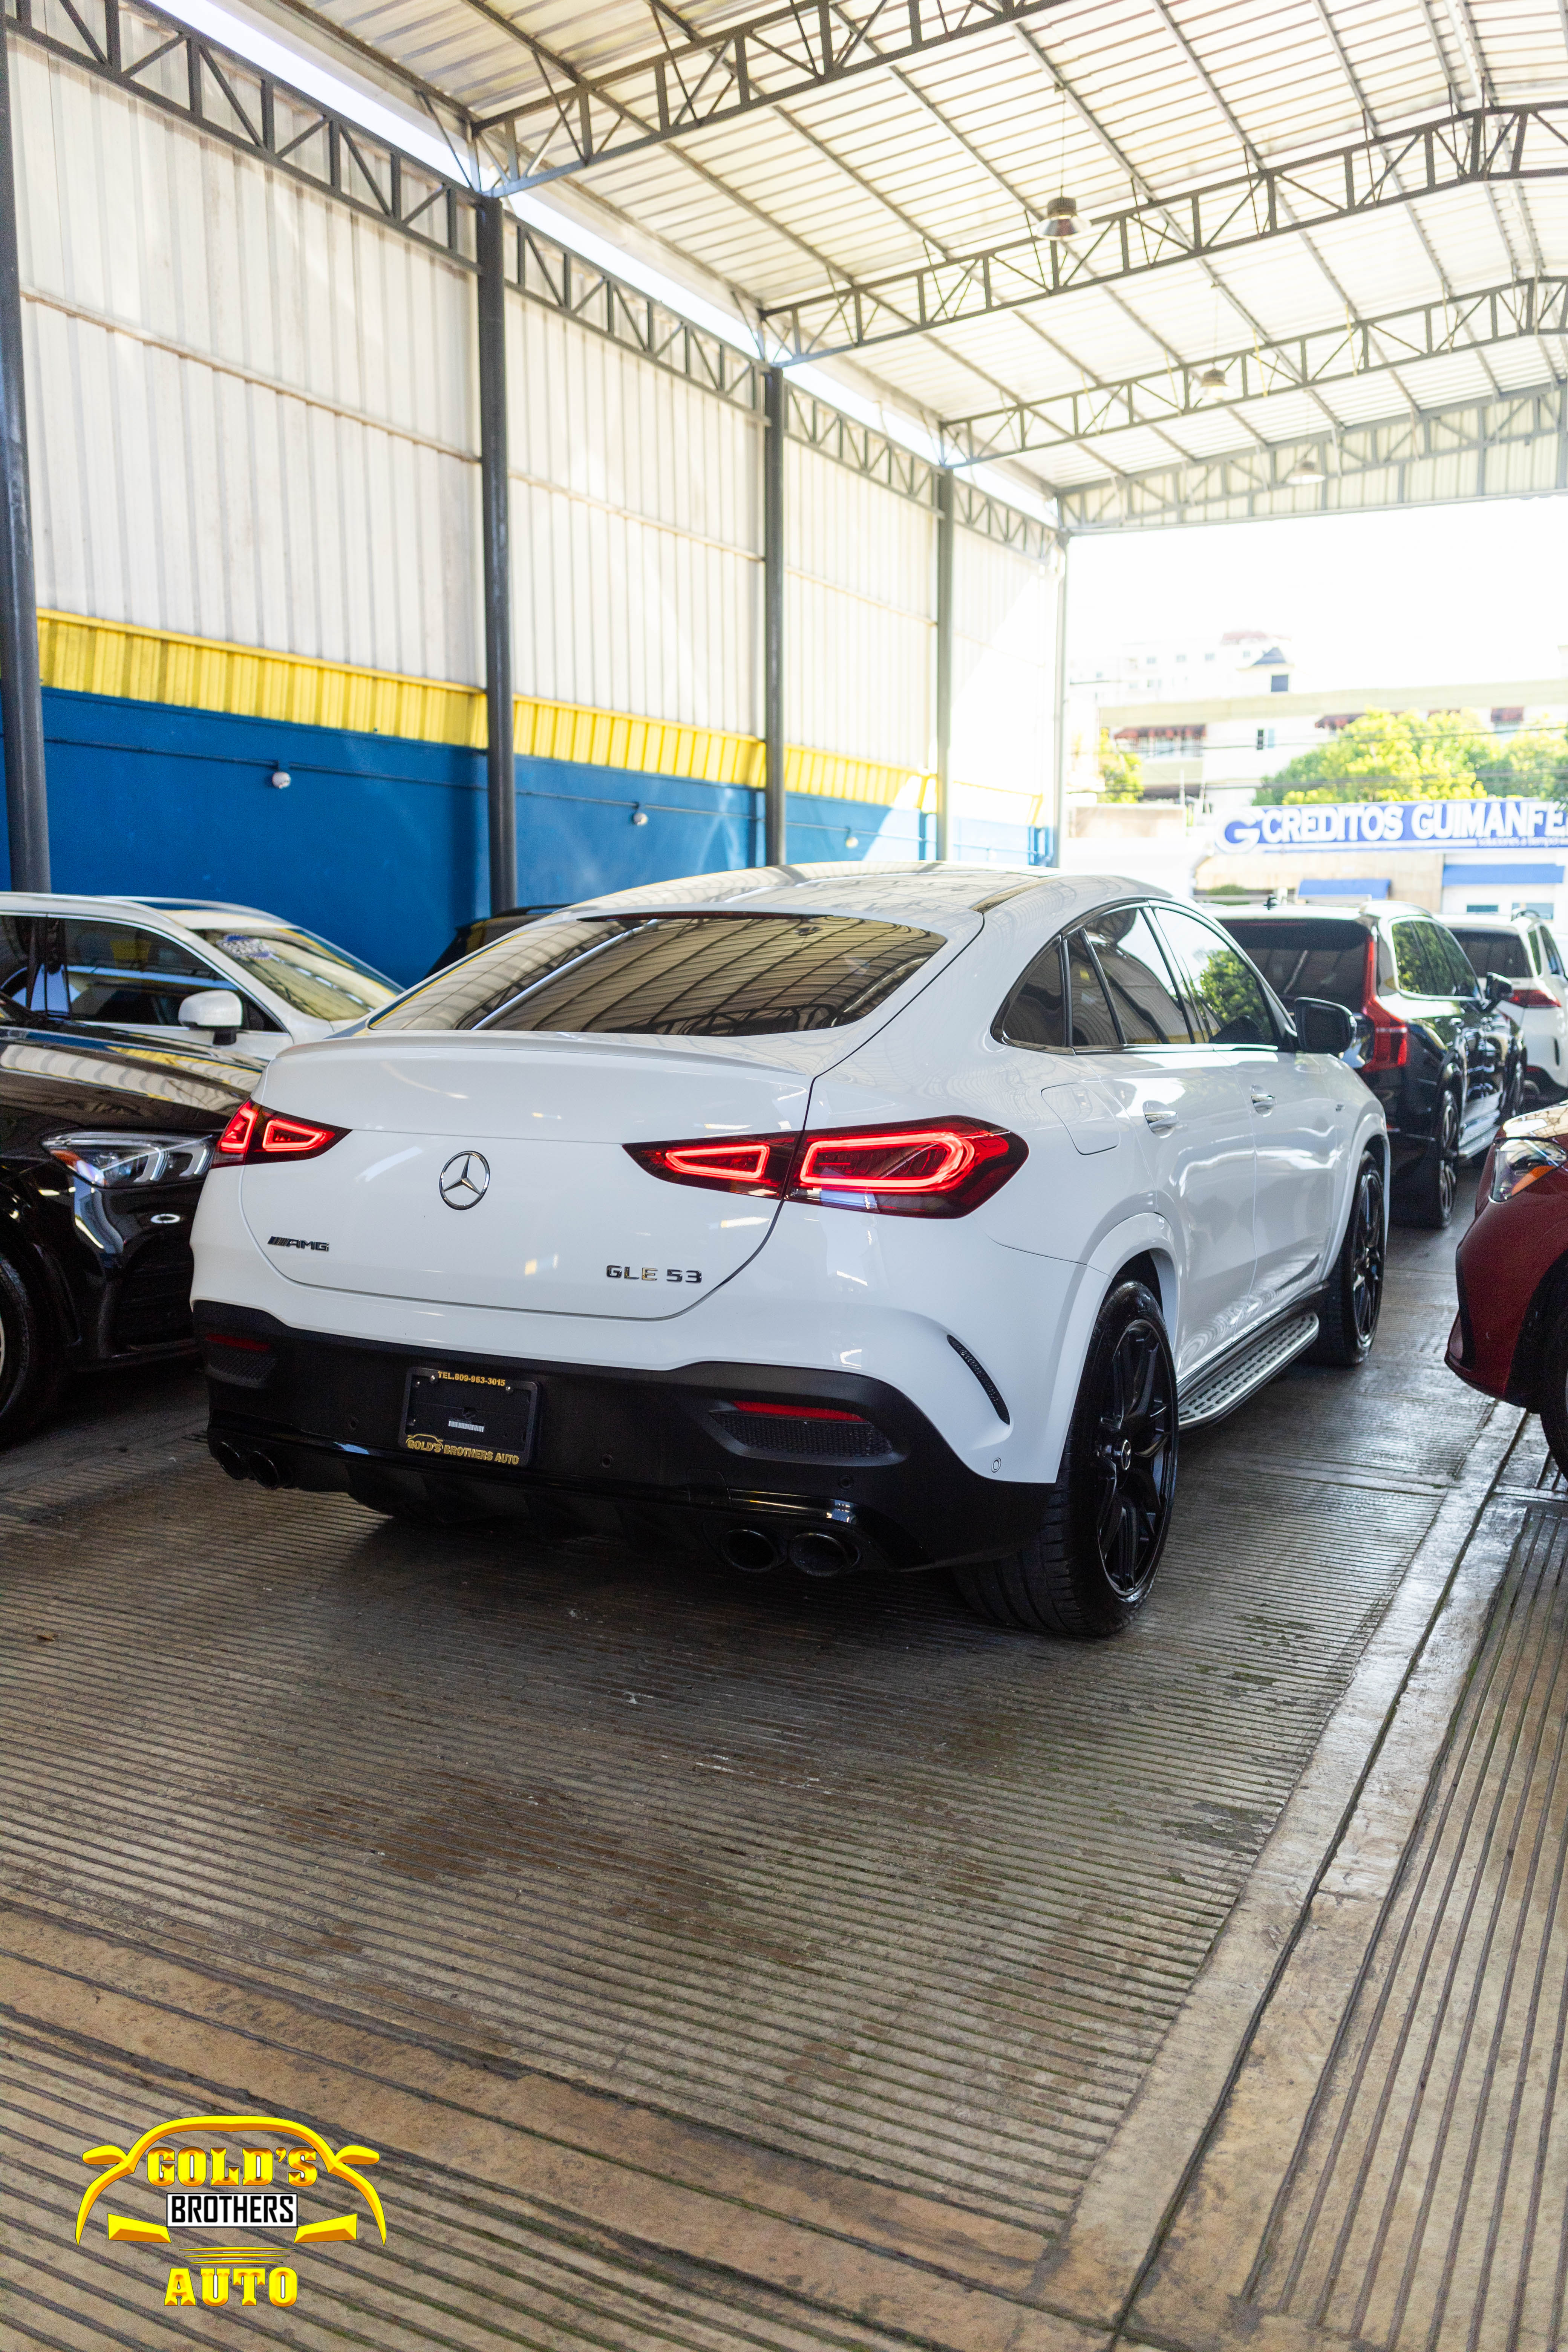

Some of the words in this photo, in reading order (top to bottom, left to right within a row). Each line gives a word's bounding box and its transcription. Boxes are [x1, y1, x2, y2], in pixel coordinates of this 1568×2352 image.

[1262, 805, 1403, 844] CREDITOS
[1411, 801, 1568, 839] GUIMANFE
[606, 1265, 658, 1281] GLE
[666, 1269, 702, 1283] 53
[407, 1439, 441, 1453] GOLD'S
[443, 1444, 493, 1461] BROTHERS
[494, 1452, 519, 1465] AUTO
